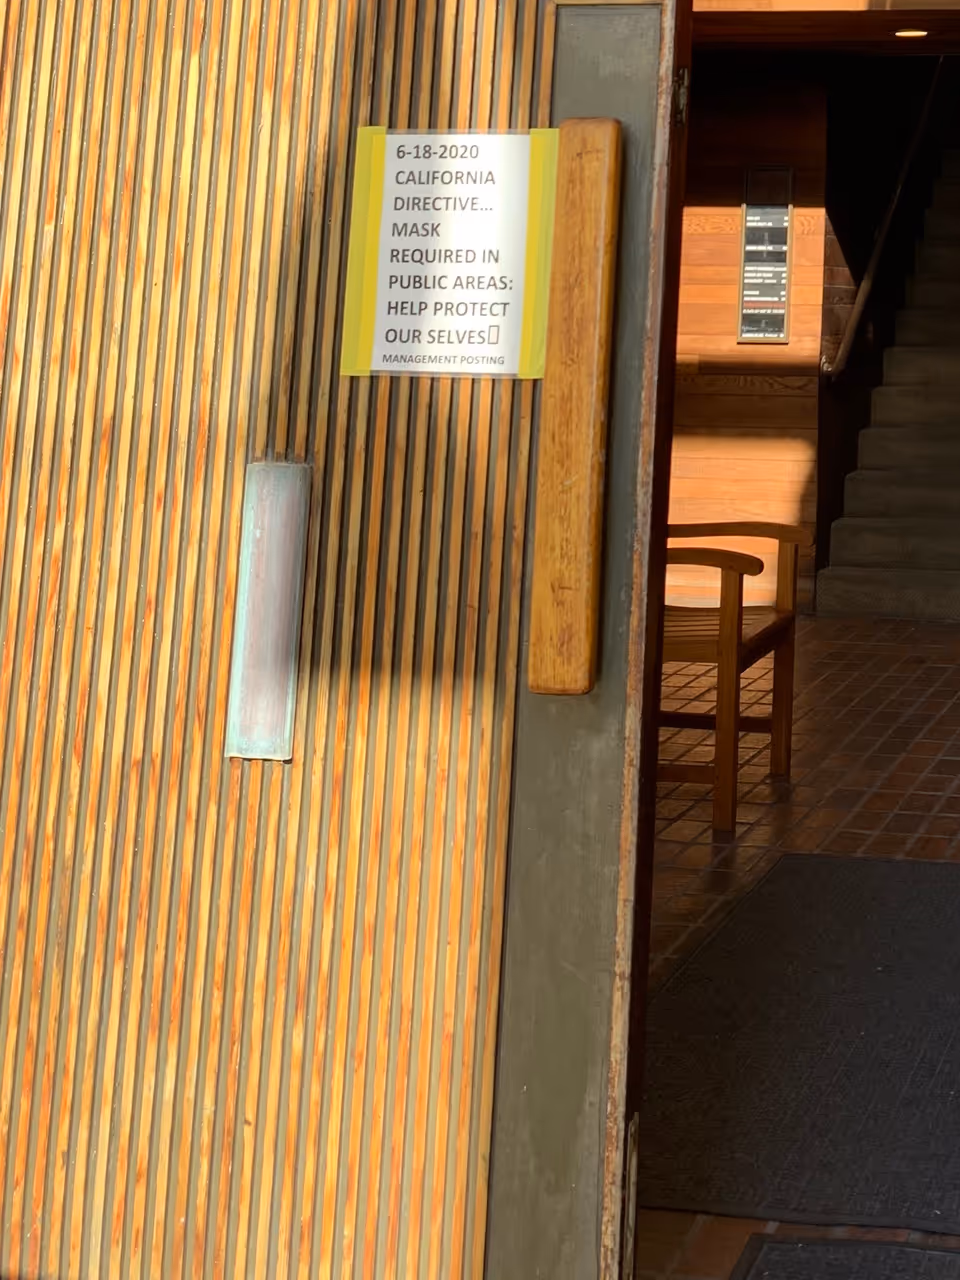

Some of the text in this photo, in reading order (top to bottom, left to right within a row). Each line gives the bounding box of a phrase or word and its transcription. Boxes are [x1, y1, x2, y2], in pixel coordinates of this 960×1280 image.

[396, 144, 479, 159] 6-18-2020
[395, 170, 496, 185] CALIFORNIA
[393, 196, 494, 211] DIRECTIVE...
[391, 222, 441, 238] MASK
[390, 248, 500, 265] REQUIRED IN
[388, 274, 513, 291] PUBLIC AREAS:
[387, 300, 510, 317] HELP PROTECT
[385, 328, 422, 344] OUR
[382, 354, 505, 365] MANAGEMENT POSTING
